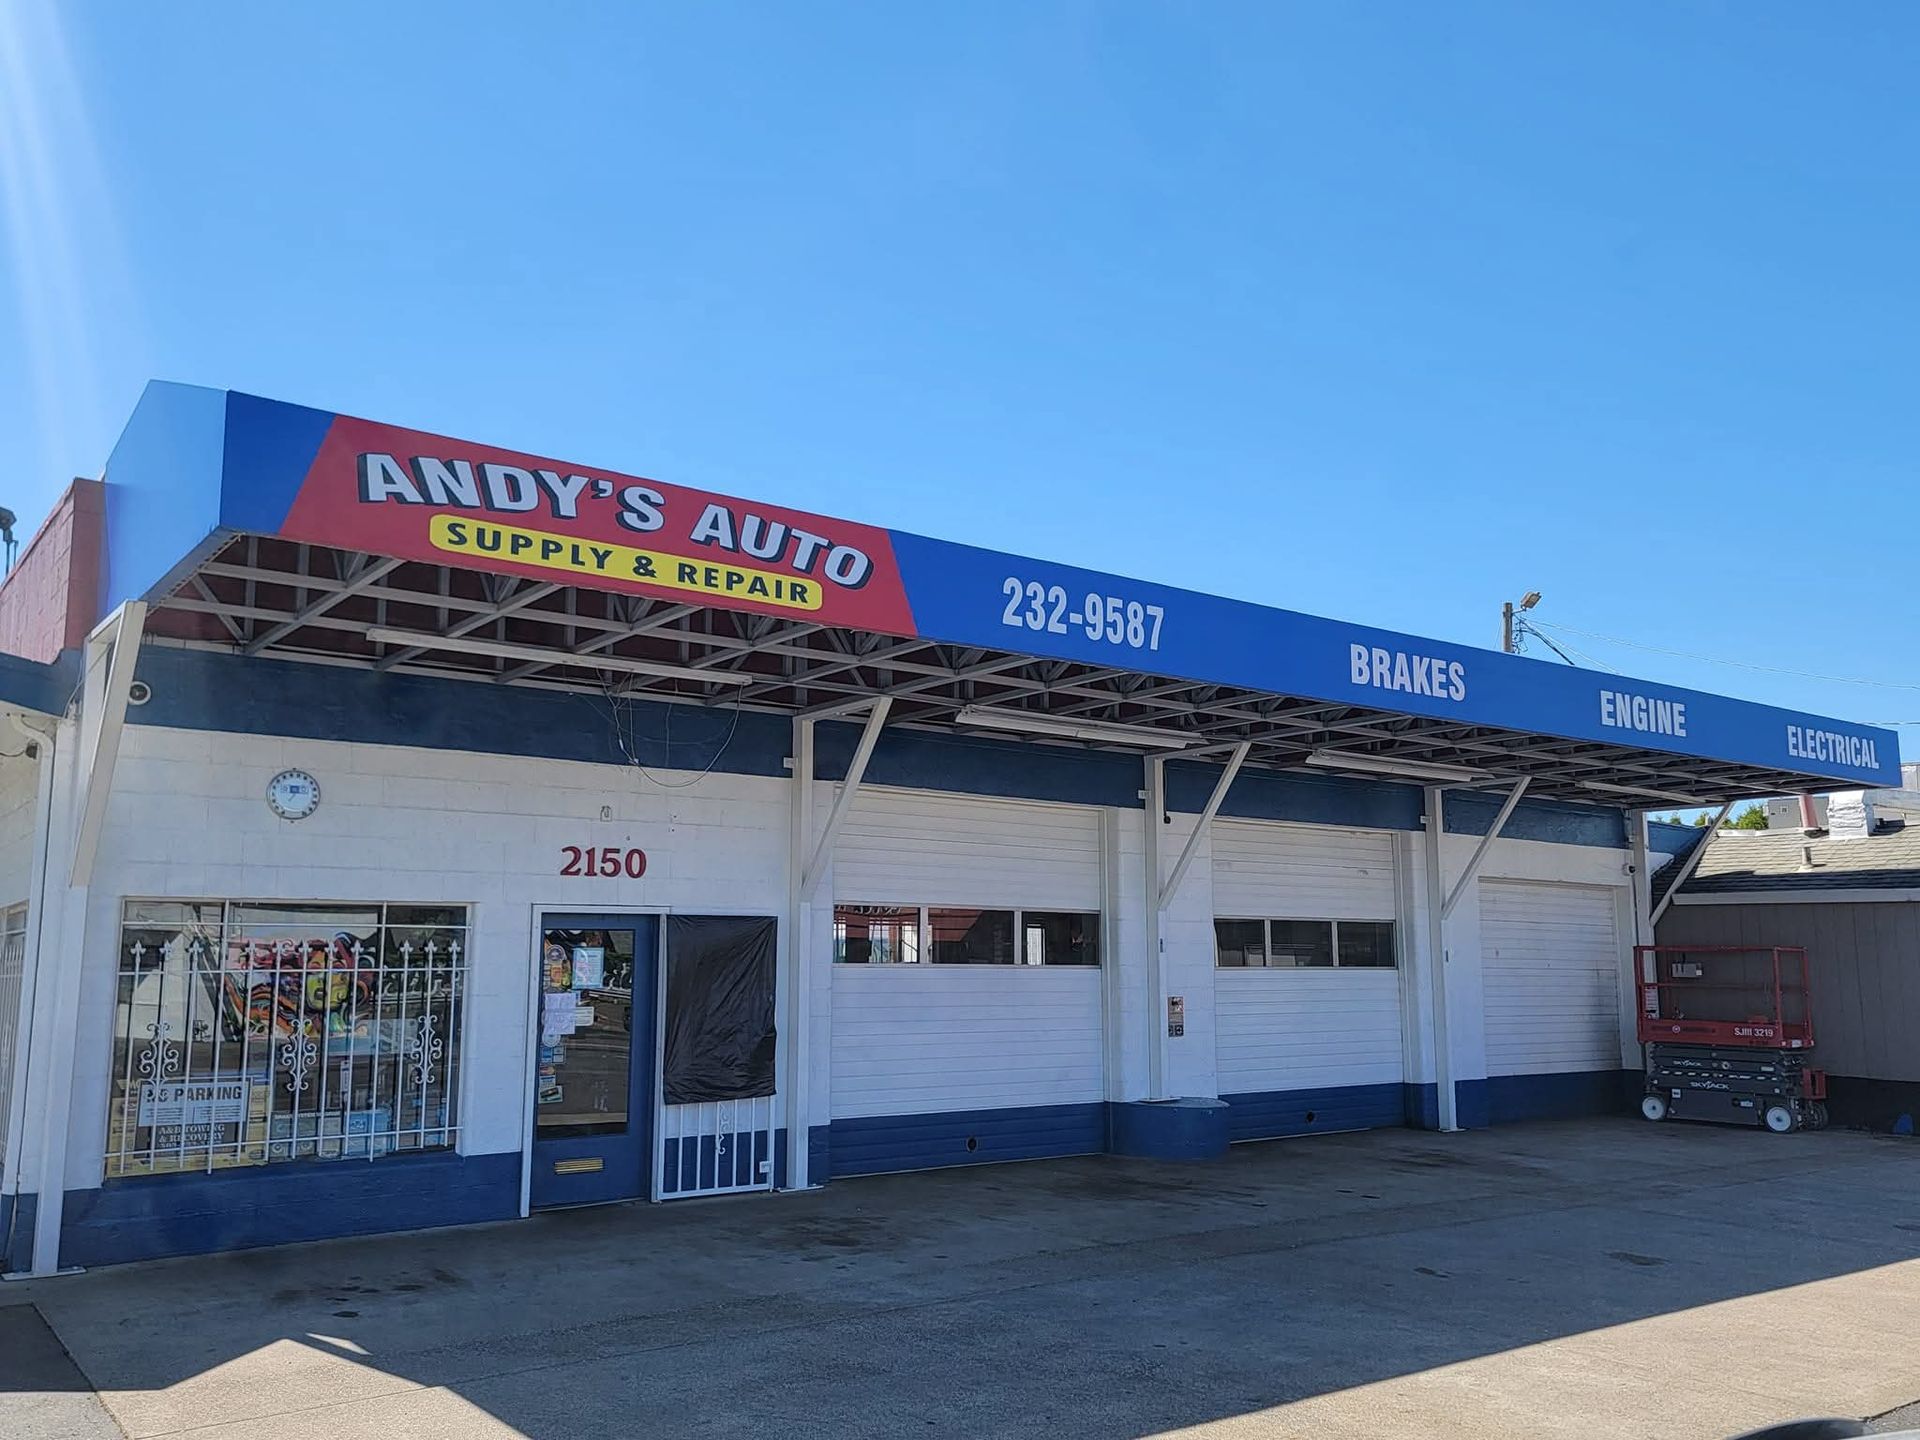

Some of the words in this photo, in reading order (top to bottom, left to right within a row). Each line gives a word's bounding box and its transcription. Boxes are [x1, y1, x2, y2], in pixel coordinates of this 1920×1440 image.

[357, 453, 666, 533] ANDY'S
[689, 502, 874, 590] AUTO
[447, 522, 613, 570] SUPPLY
[632, 555, 657, 578] &
[677, 562, 809, 604] REPAIR
[1002, 576, 1165, 650] 232-9587
[1349, 643, 1466, 702] BRAKES
[1600, 689, 1687, 737] ENGINE
[1786, 725, 1880, 770] ELECTRICAL
[560, 846, 647, 879] 2150
[1754, 1028, 1774, 1037] 3219
[174, 1086, 242, 1102] PARKING
[1689, 1081, 1730, 1090] SKYJACK
